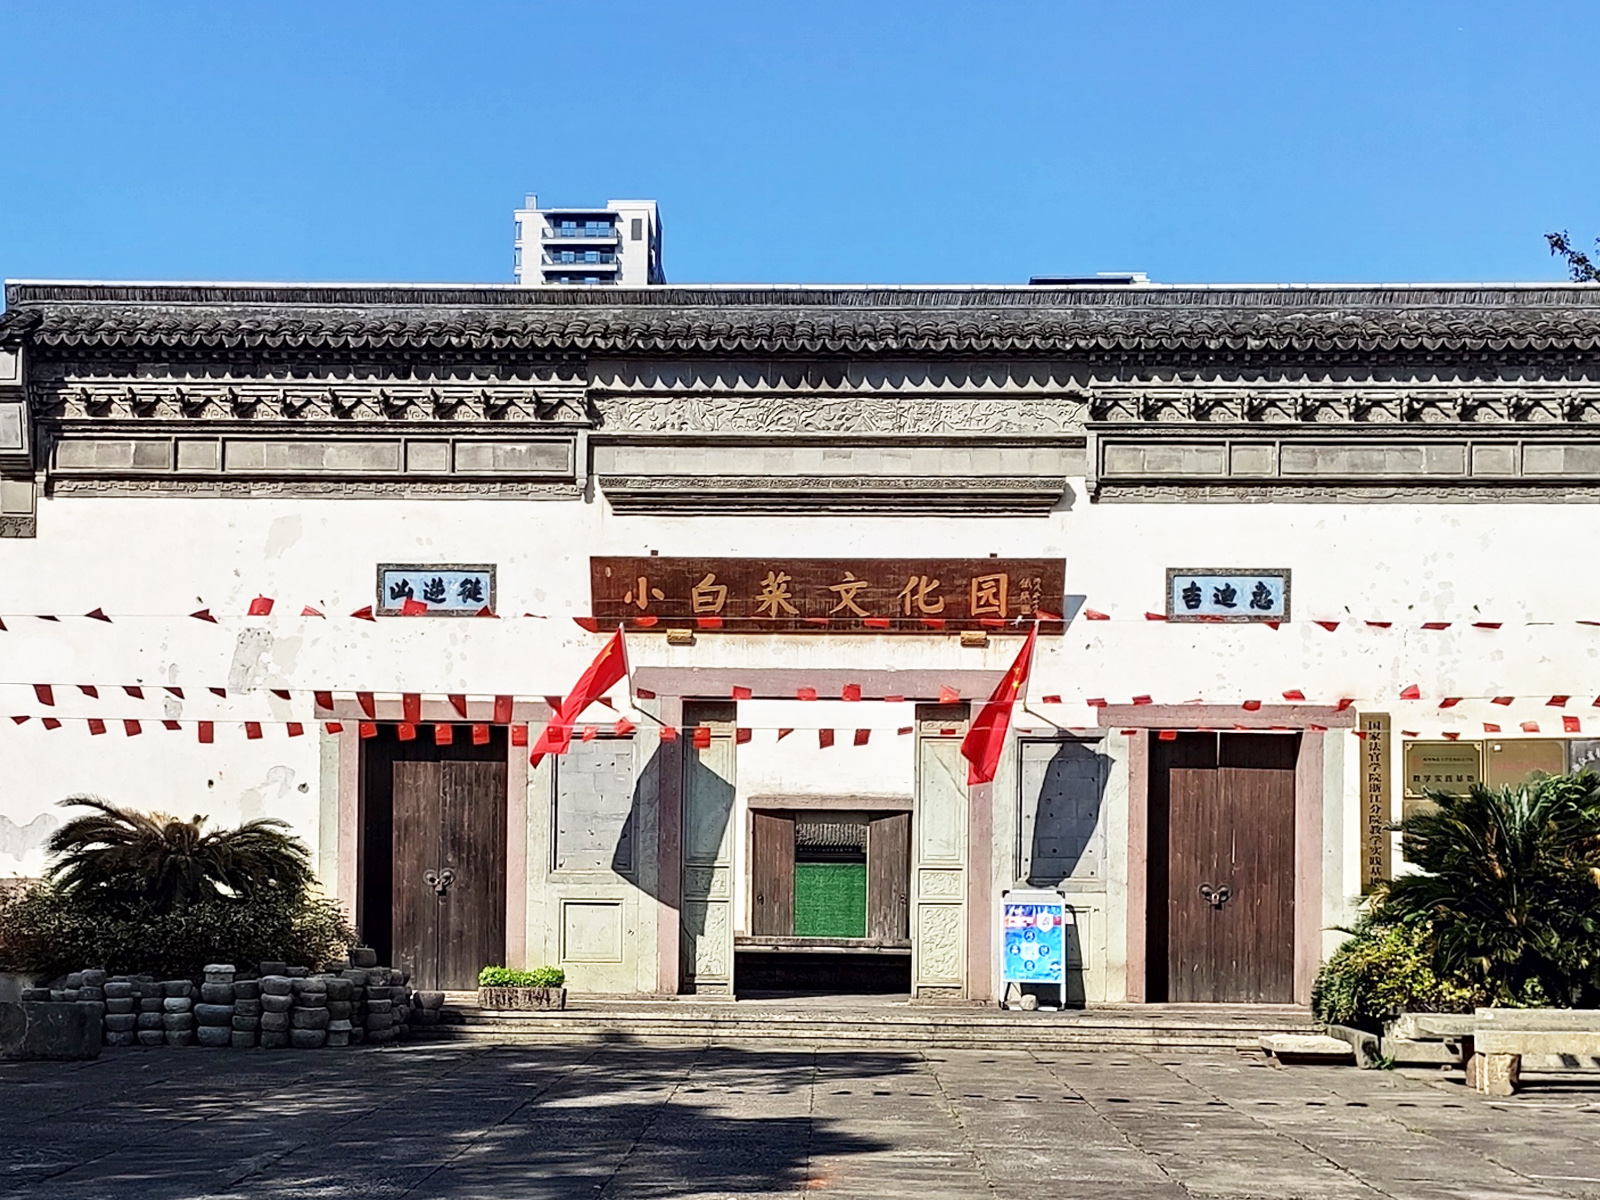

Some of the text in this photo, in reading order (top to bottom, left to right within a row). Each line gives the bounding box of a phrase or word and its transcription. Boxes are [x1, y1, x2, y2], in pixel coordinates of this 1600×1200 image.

[623, 570, 1008, 619] 小白菜文化园
